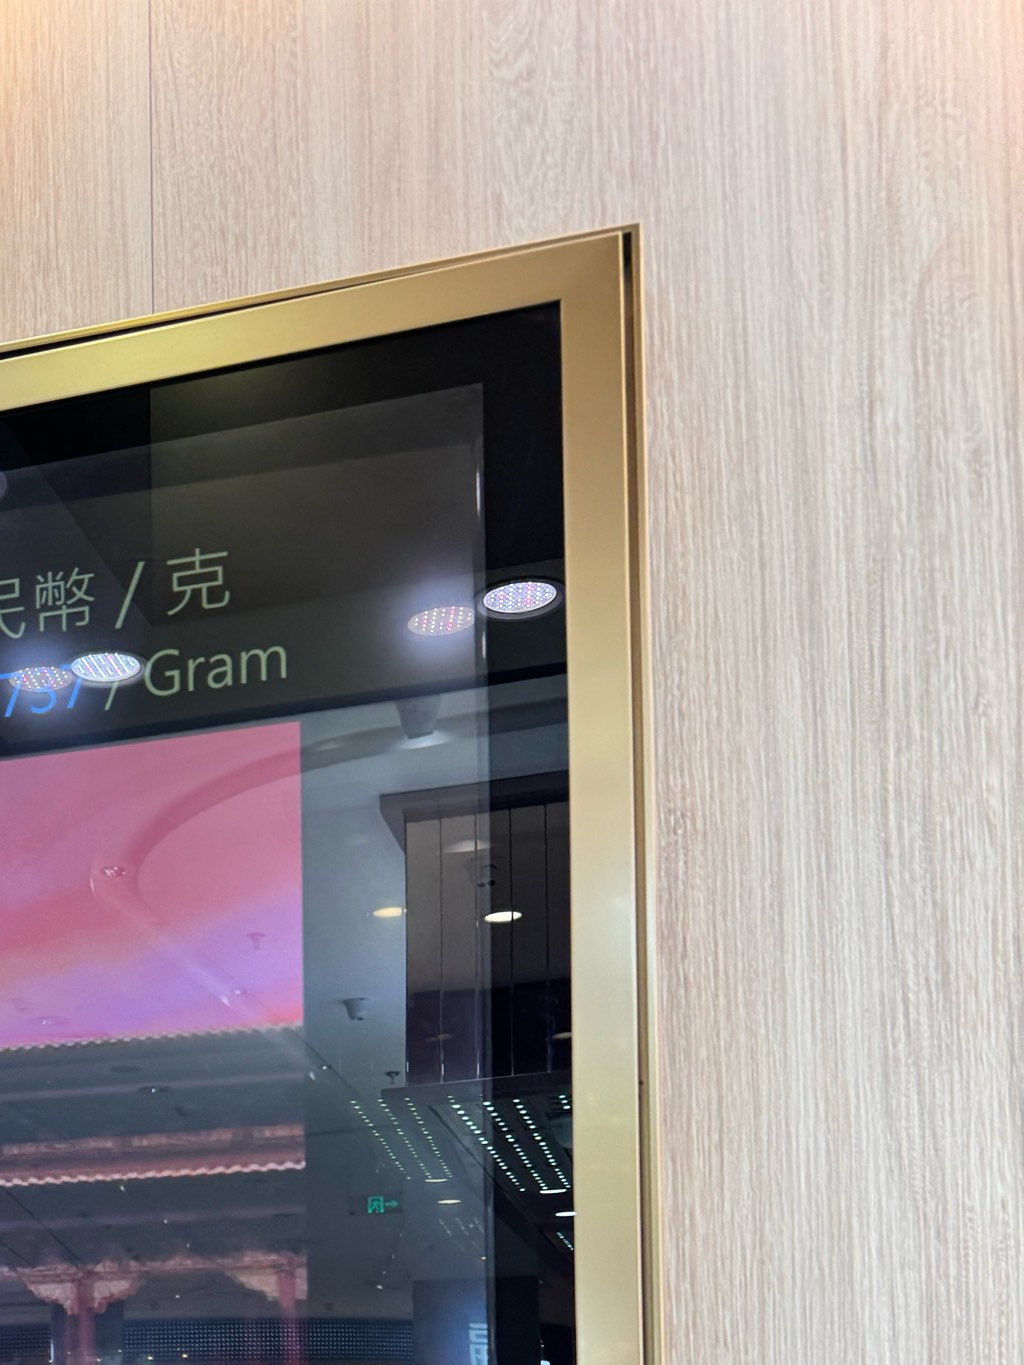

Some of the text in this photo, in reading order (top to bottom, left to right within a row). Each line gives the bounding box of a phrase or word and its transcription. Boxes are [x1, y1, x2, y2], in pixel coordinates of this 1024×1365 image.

[114, 561, 145, 629] /
[166, 548, 230, 616] 克
[144, 645, 287, 697] Gram
